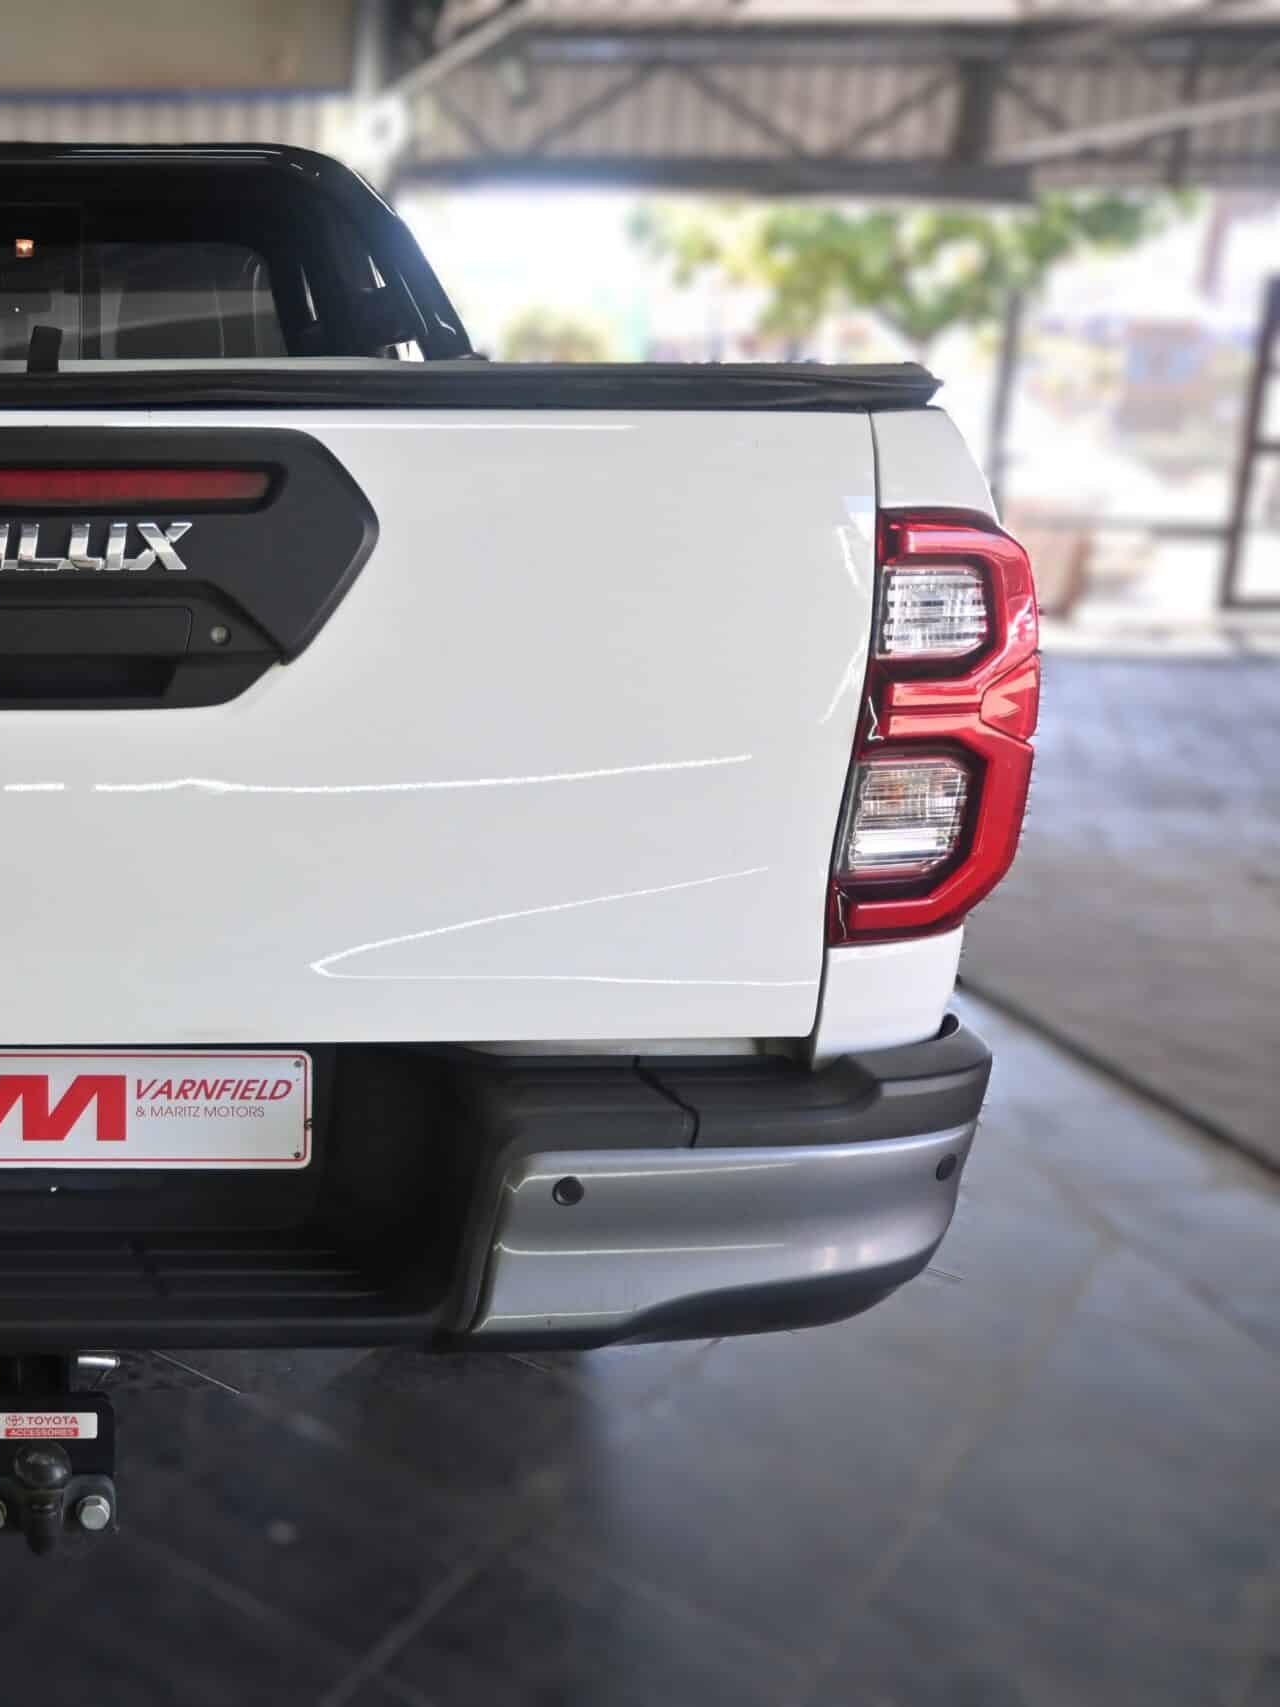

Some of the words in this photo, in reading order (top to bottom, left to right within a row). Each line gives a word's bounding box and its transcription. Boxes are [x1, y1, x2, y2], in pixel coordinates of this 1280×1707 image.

[135, 1079, 293, 1101] VARNFIELD
[135, 1105, 145, 1118] &
[150, 1105, 200, 1118] MARITZ
[204, 1105, 265, 1118] MOTORS
[26, 1415, 79, 1425] TOYOTA
